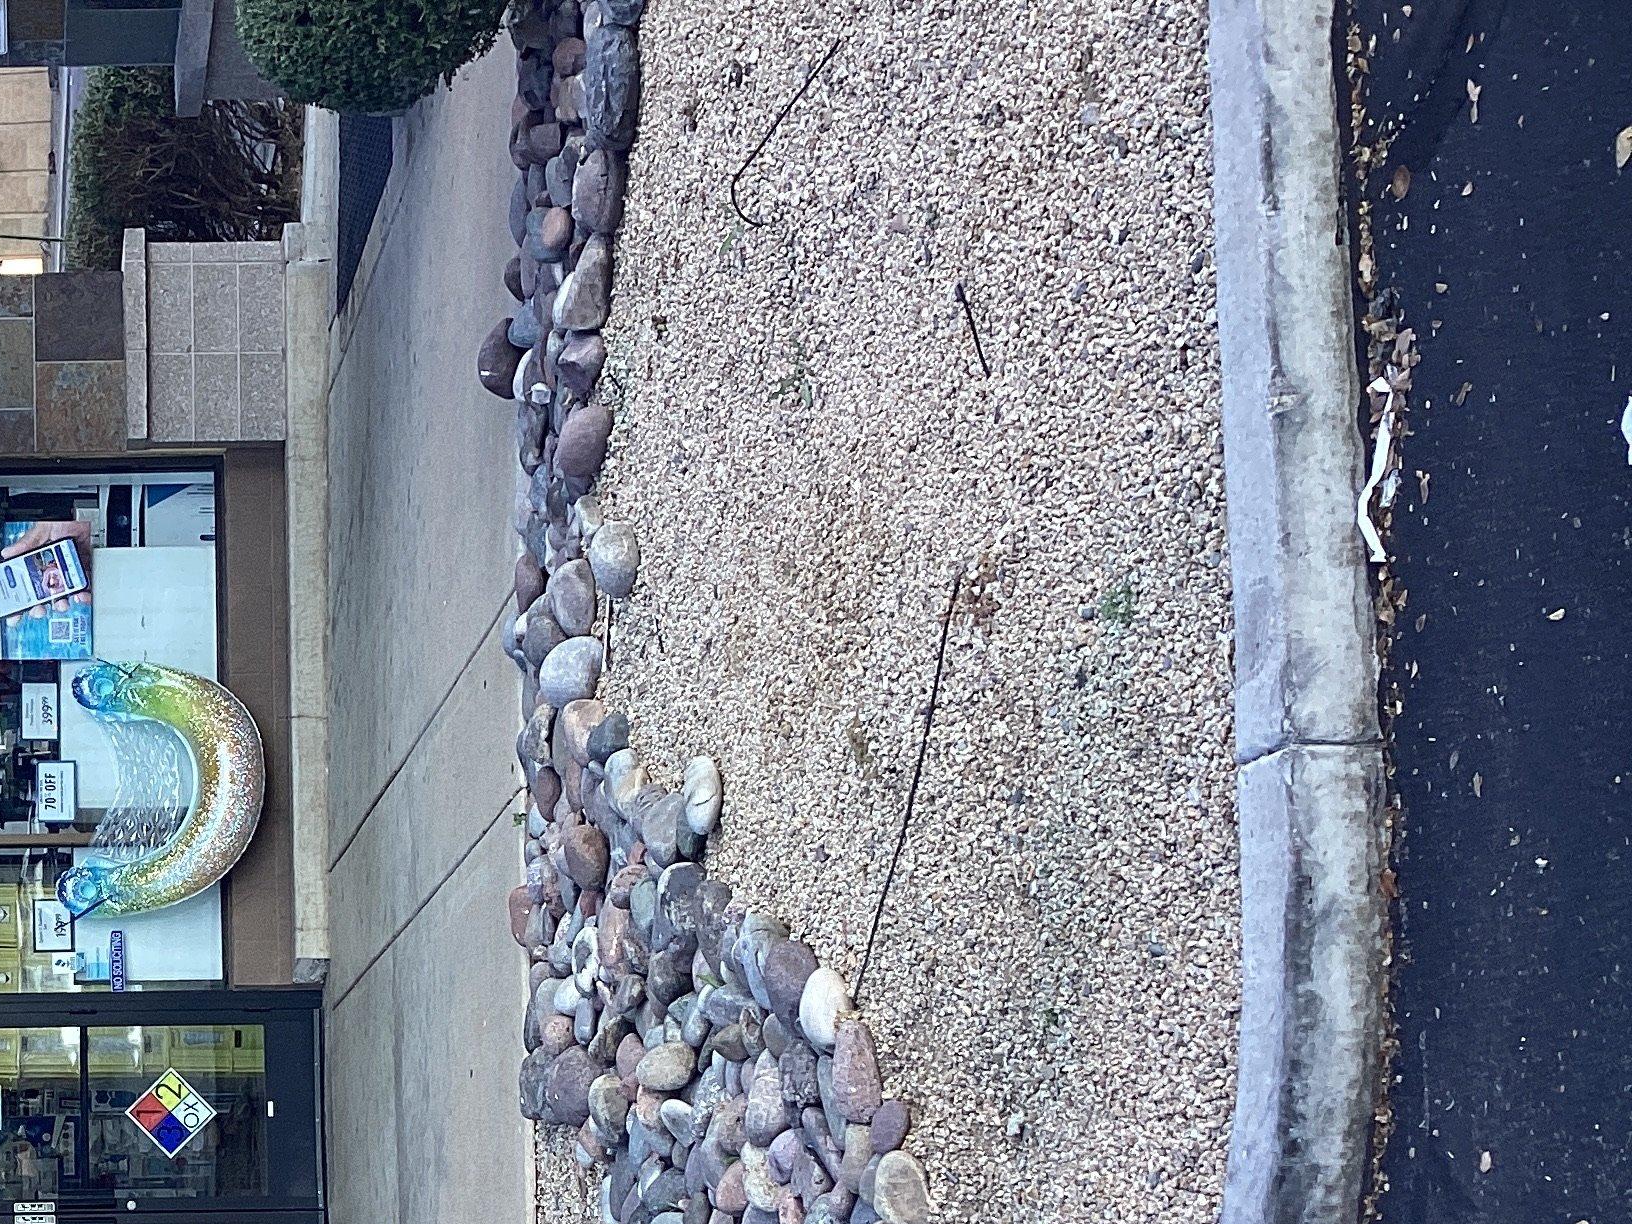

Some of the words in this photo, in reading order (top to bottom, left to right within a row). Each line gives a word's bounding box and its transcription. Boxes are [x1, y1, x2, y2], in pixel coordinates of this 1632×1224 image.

[44, 772, 56, 791] OFF
[112, 932, 123, 975] SOLICITING
[113, 977, 123, 989] NO
[155, 1083, 182, 1100] 2
[136, 1109, 163, 1118] 1
[183, 1101, 200, 1129] OX
